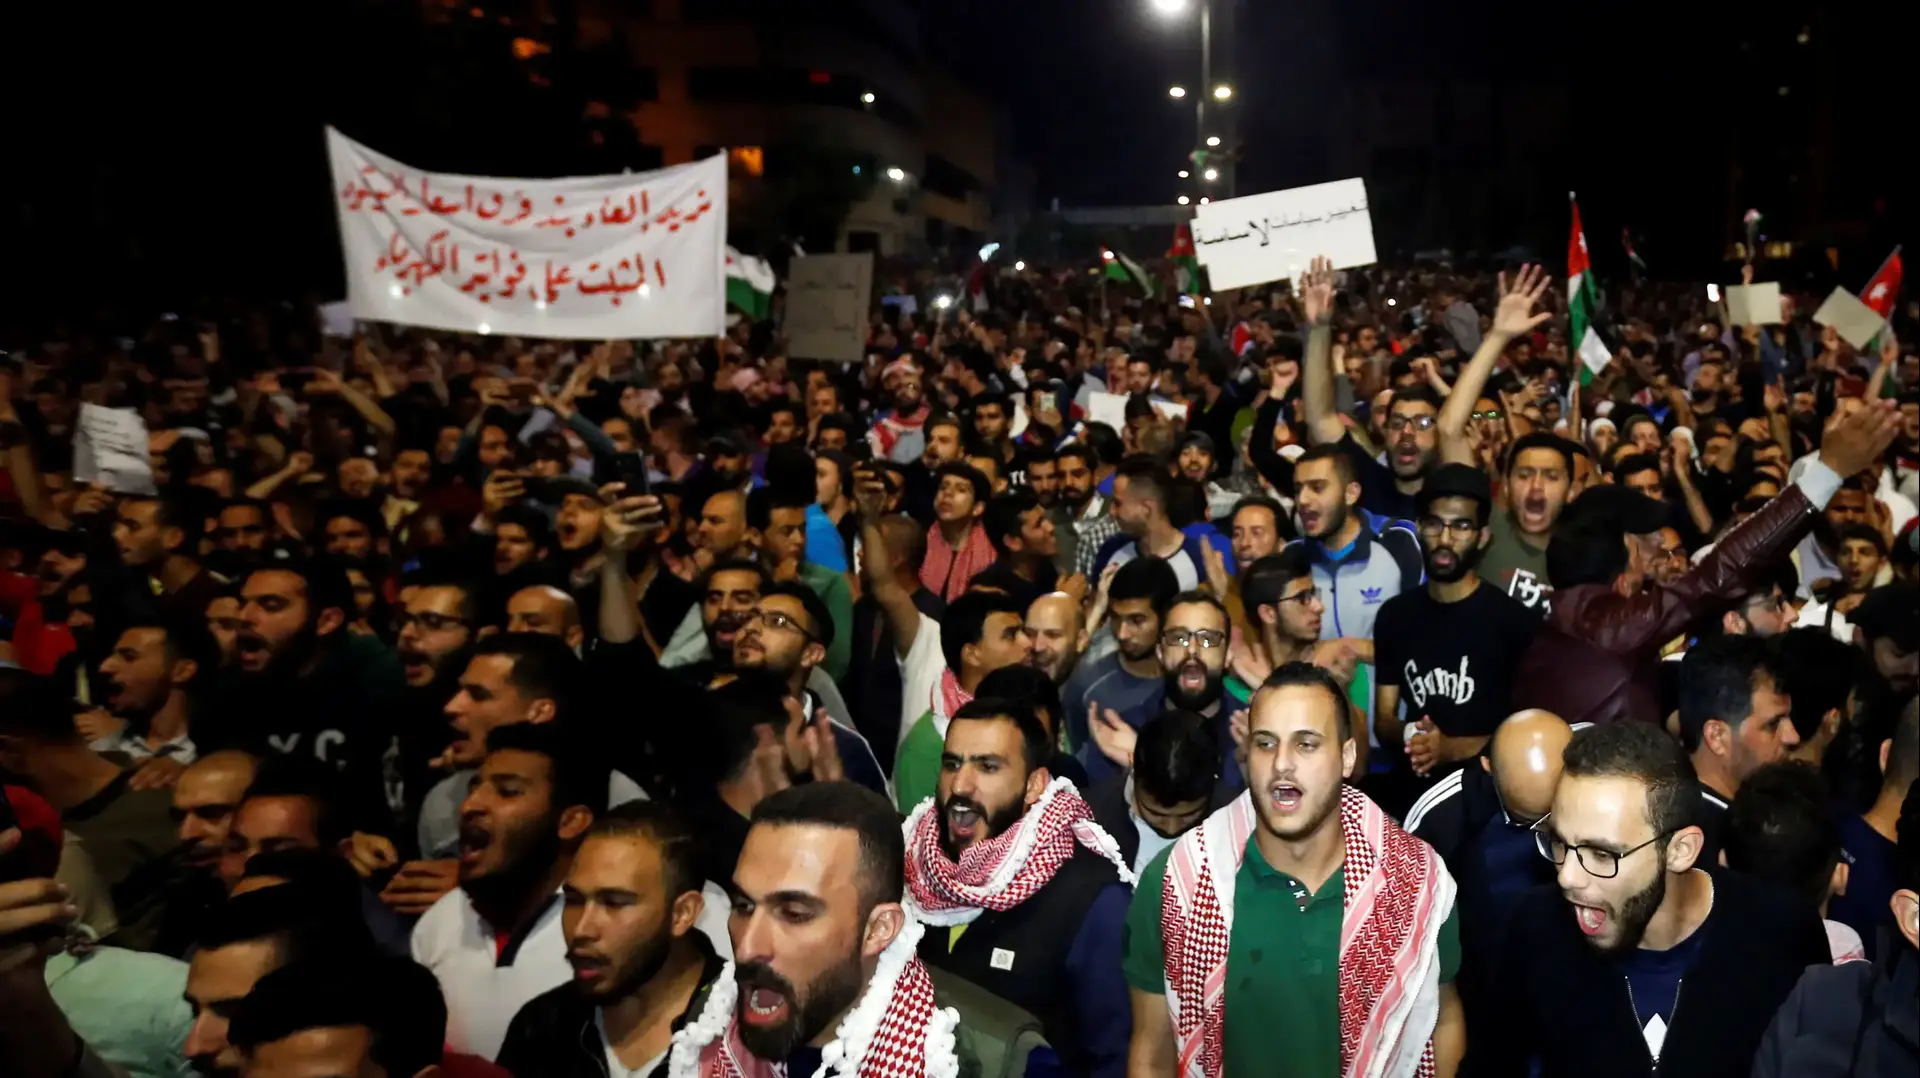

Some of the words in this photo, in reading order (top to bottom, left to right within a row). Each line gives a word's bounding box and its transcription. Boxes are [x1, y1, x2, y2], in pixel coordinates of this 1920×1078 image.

[533, 194, 577, 239] بند
[655, 188, 712, 233] نريد
[458, 249, 527, 304] فواتير
[577, 252, 666, 308] المثبت
